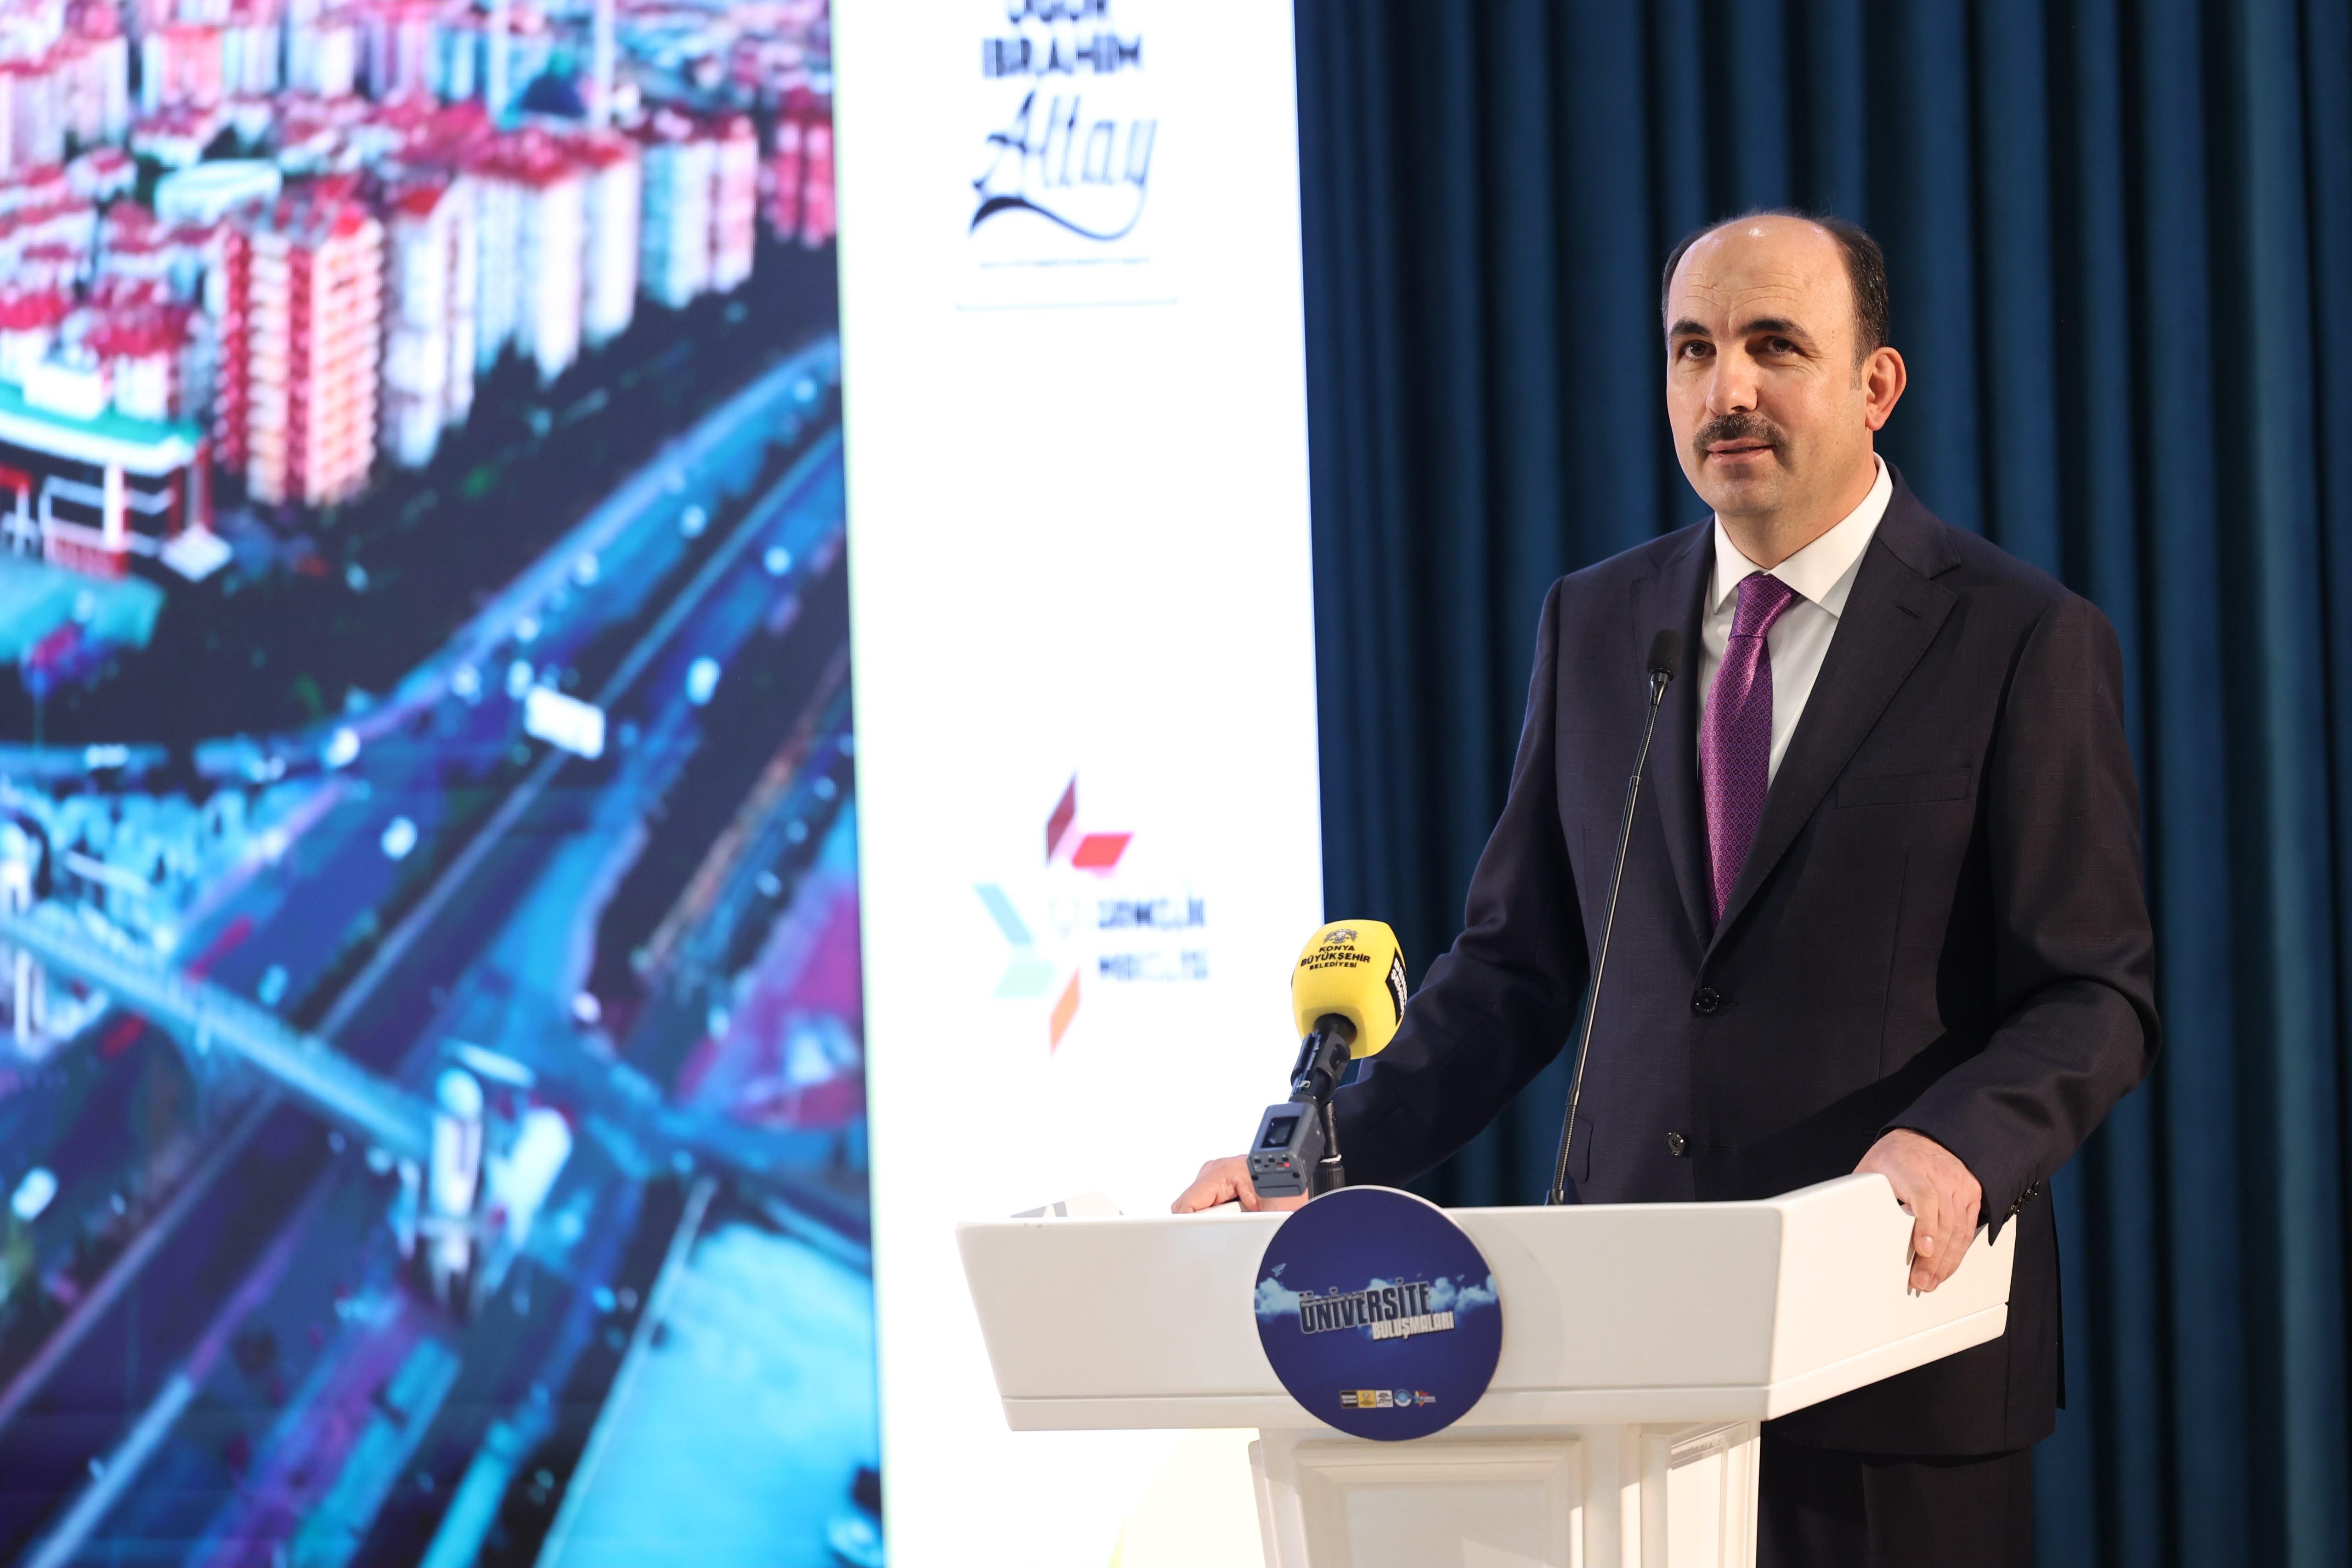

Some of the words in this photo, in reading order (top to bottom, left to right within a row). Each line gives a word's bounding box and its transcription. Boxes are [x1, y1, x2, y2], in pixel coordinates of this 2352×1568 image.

[1300, 952, 1371, 966] BÜYÜKŞEHİR
[1309, 960, 1357, 970] BELEDİYESİ
[1299, 1277, 1430, 1334] ÜNİVERSİTE
[1372, 1311, 1455, 1340] BULUŞMALARI
